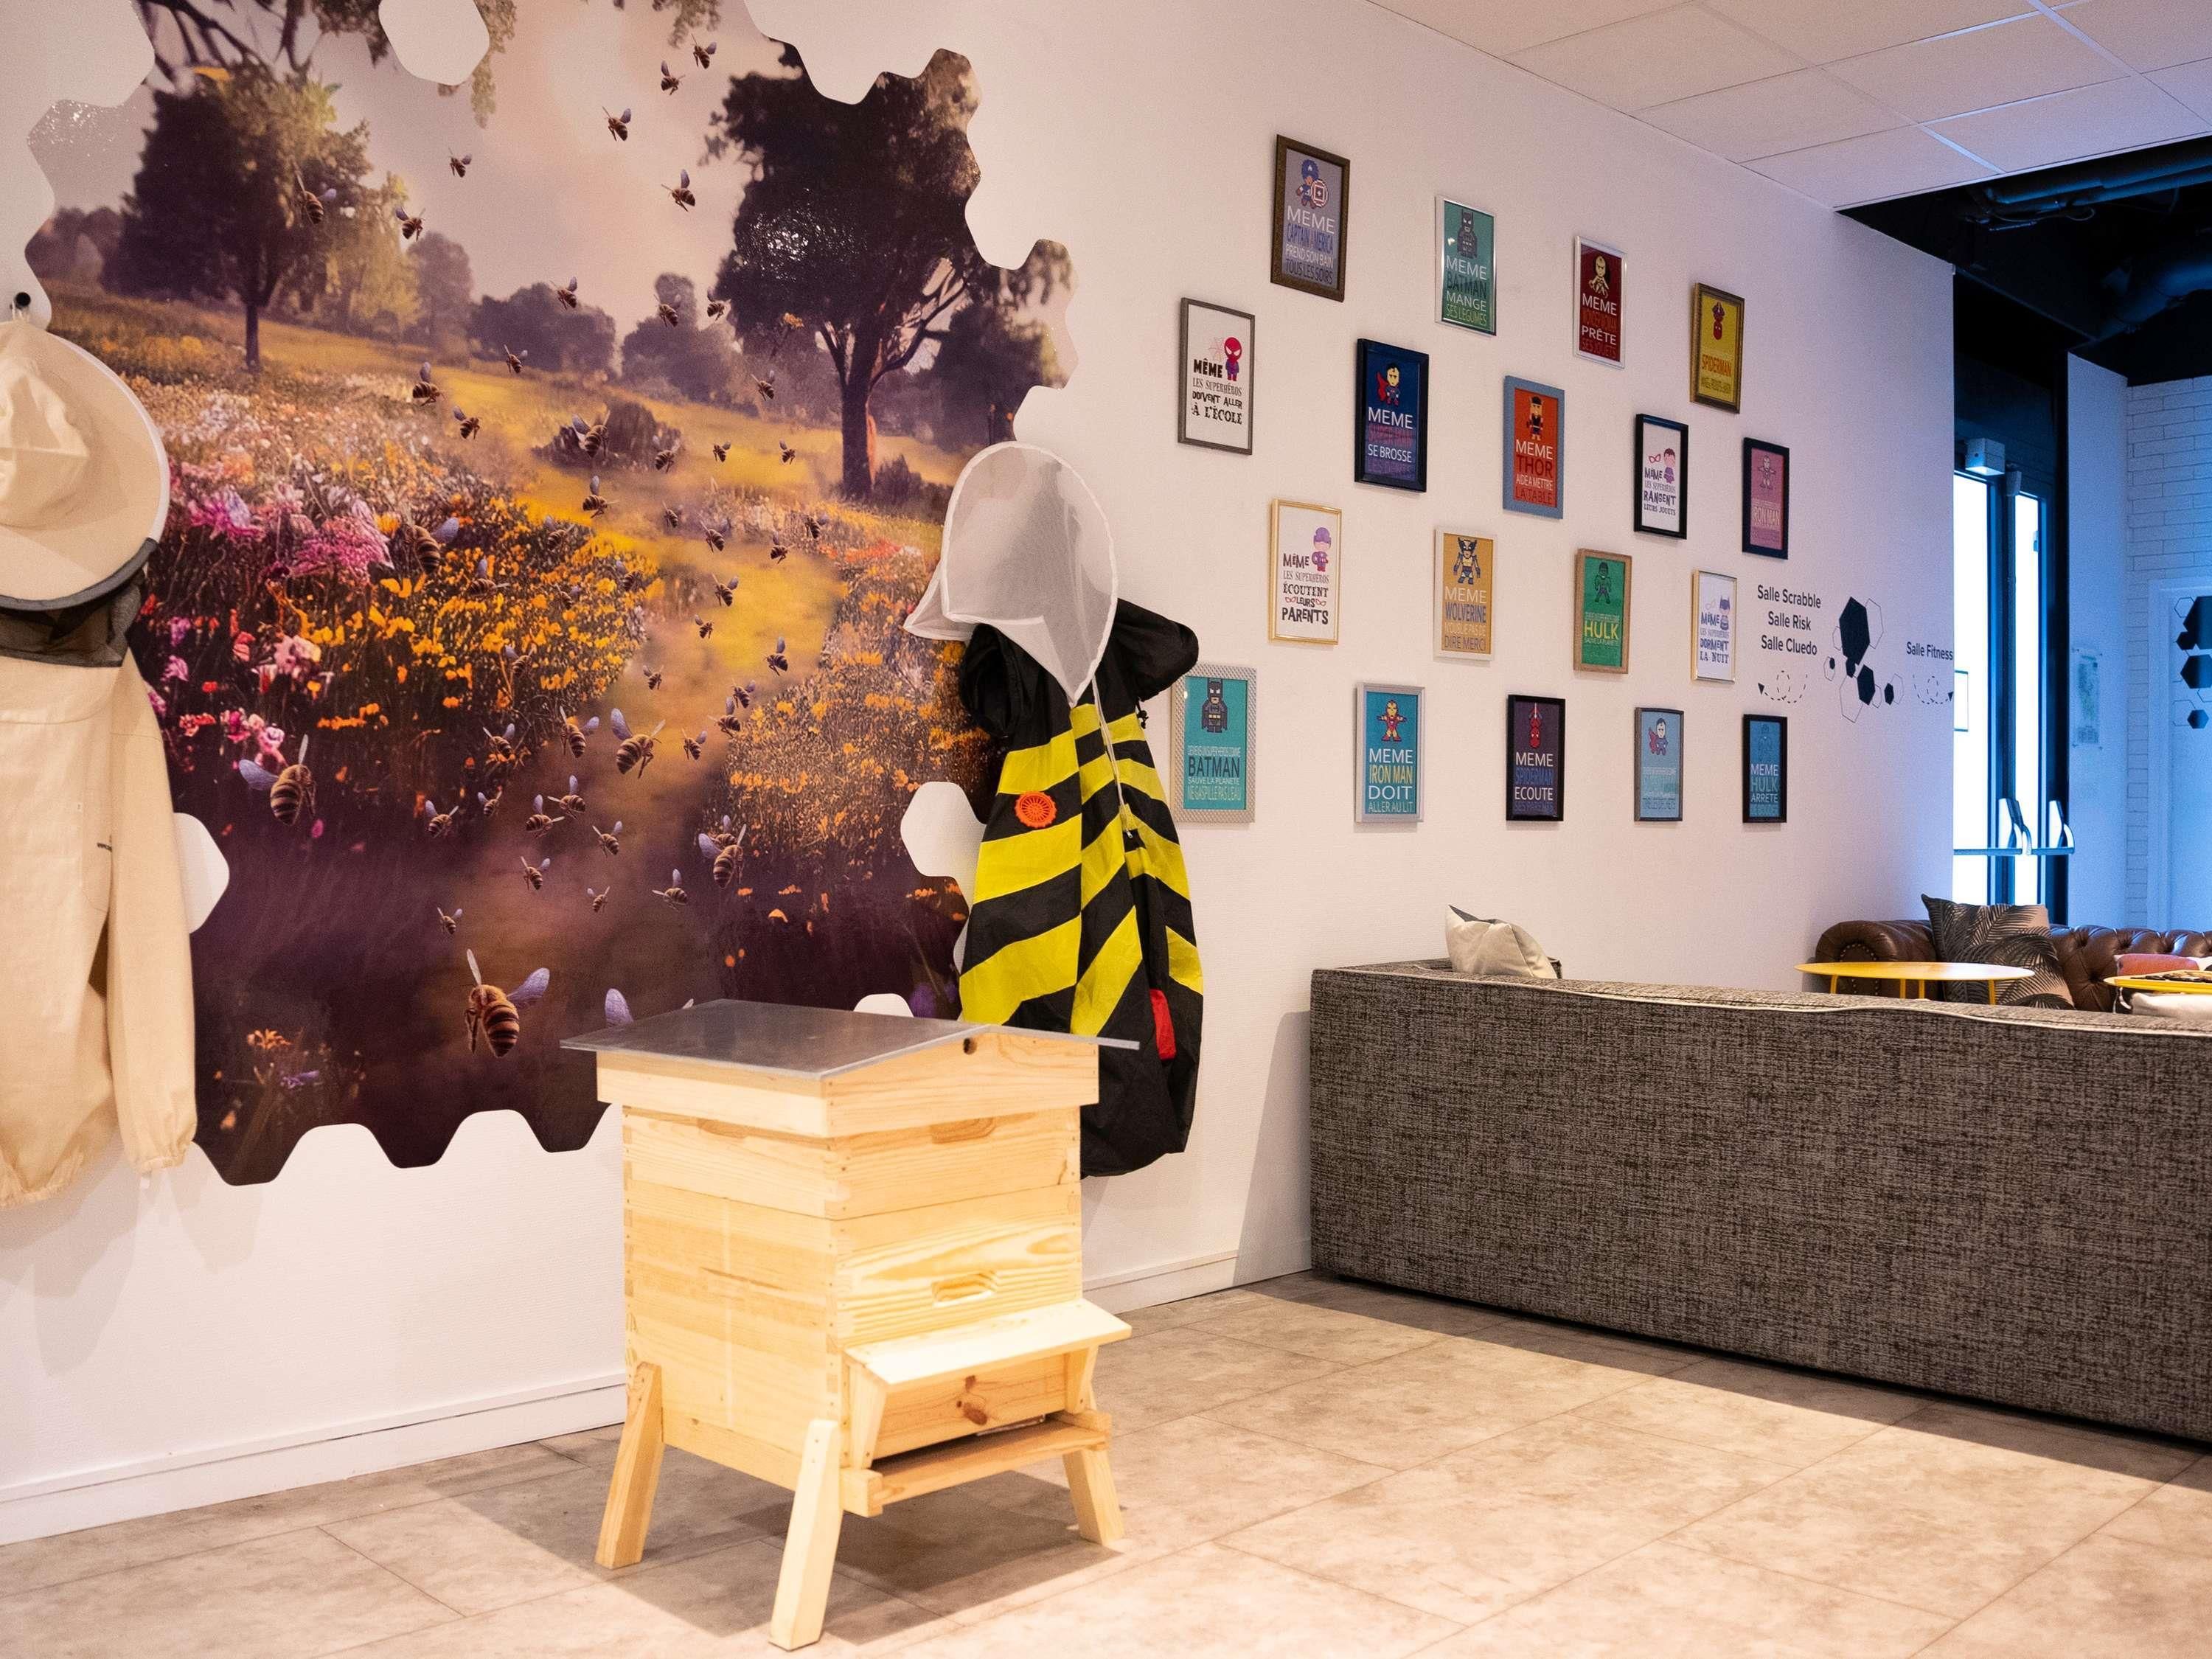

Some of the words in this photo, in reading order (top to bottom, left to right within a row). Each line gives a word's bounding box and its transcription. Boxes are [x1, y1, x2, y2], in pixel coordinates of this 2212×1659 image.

[1287, 206, 1335, 234] MEME
[1286, 244, 1306, 260] PREND
[1307, 251, 1319, 263] SON
[1319, 254, 1333, 268] BAIN
[1286, 259, 1302, 276] TOUS
[1304, 263, 1314, 279] LES
[1315, 267, 1333, 285] SOIRS
[1446, 255, 1486, 280] MEME
[1447, 271, 1486, 299] BATMAN
[1446, 291, 1486, 312] MANGE
[1582, 293, 1617, 316] MEME
[1446, 304, 1457, 319] SES
[1582, 324, 1616, 345] PRÊTE
[1194, 358, 1223, 378] MÊME
[1193, 377, 1203, 389] LES
[1192, 391, 1220, 404] DOIVENT
[1223, 397, 1242, 410] ALLER
[1191, 402, 1200, 416] À
[1205, 406, 1242, 425] L'ÉCOLE
[1368, 406, 1413, 429] MEME
[1368, 444, 1379, 457] SE
[1380, 446, 1412, 463] BROSSE
[1516, 439, 1553, 459] MEME
[1516, 454, 1553, 478] THOR
[1516, 487, 1526, 499] LA
[1526, 488, 1552, 504] TABLE
[1644, 490, 1676, 506] RANGENT
[1284, 570, 1293, 580] LES
[1283, 581, 1328, 597] ÉCOUTENT
[1445, 586, 1487, 603] MEME
[1758, 585, 1779, 602] Salle
[1783, 588, 1821, 608] Scrabble
[1296, 597, 1315, 608] LEURS
[1282, 607, 1328, 625] PARENTS
[1445, 602, 1486, 623] WOLVERINE
[1768, 611, 1790, 627] Salle
[1792, 614, 1812, 630] Risk
[1585, 620, 1618, 640] HULK
[1445, 636, 1461, 649] DIRE
[1700, 638, 1729, 652] DORMENT
[1761, 635, 1783, 651] Salle
[1786, 638, 1818, 655] Cluedo
[1907, 641, 1925, 655] Salle
[1927, 644, 1953, 660] Fitness
[1700, 651, 1708, 661] LA
[1711, 653, 1729, 664] NUIT
[1369, 748, 1413, 764] MEME
[1516, 751, 1554, 767] MEME
[1189, 756, 1240, 778] BATMAN
[1369, 765, 1391, 784] IRON
[1393, 765, 1413, 784] MAN
[1751, 763, 1778, 776] MEME
[1368, 785, 1413, 800] DOIT
[1514, 786, 1554, 801] ECOUTE
[1751, 776, 1778, 792] HULK
[1368, 801, 1390, 813] ALLER
[1392, 801, 1401, 813] AU
[1402, 801, 1413, 813] LIT
[1751, 793, 1778, 803] ARRETE
